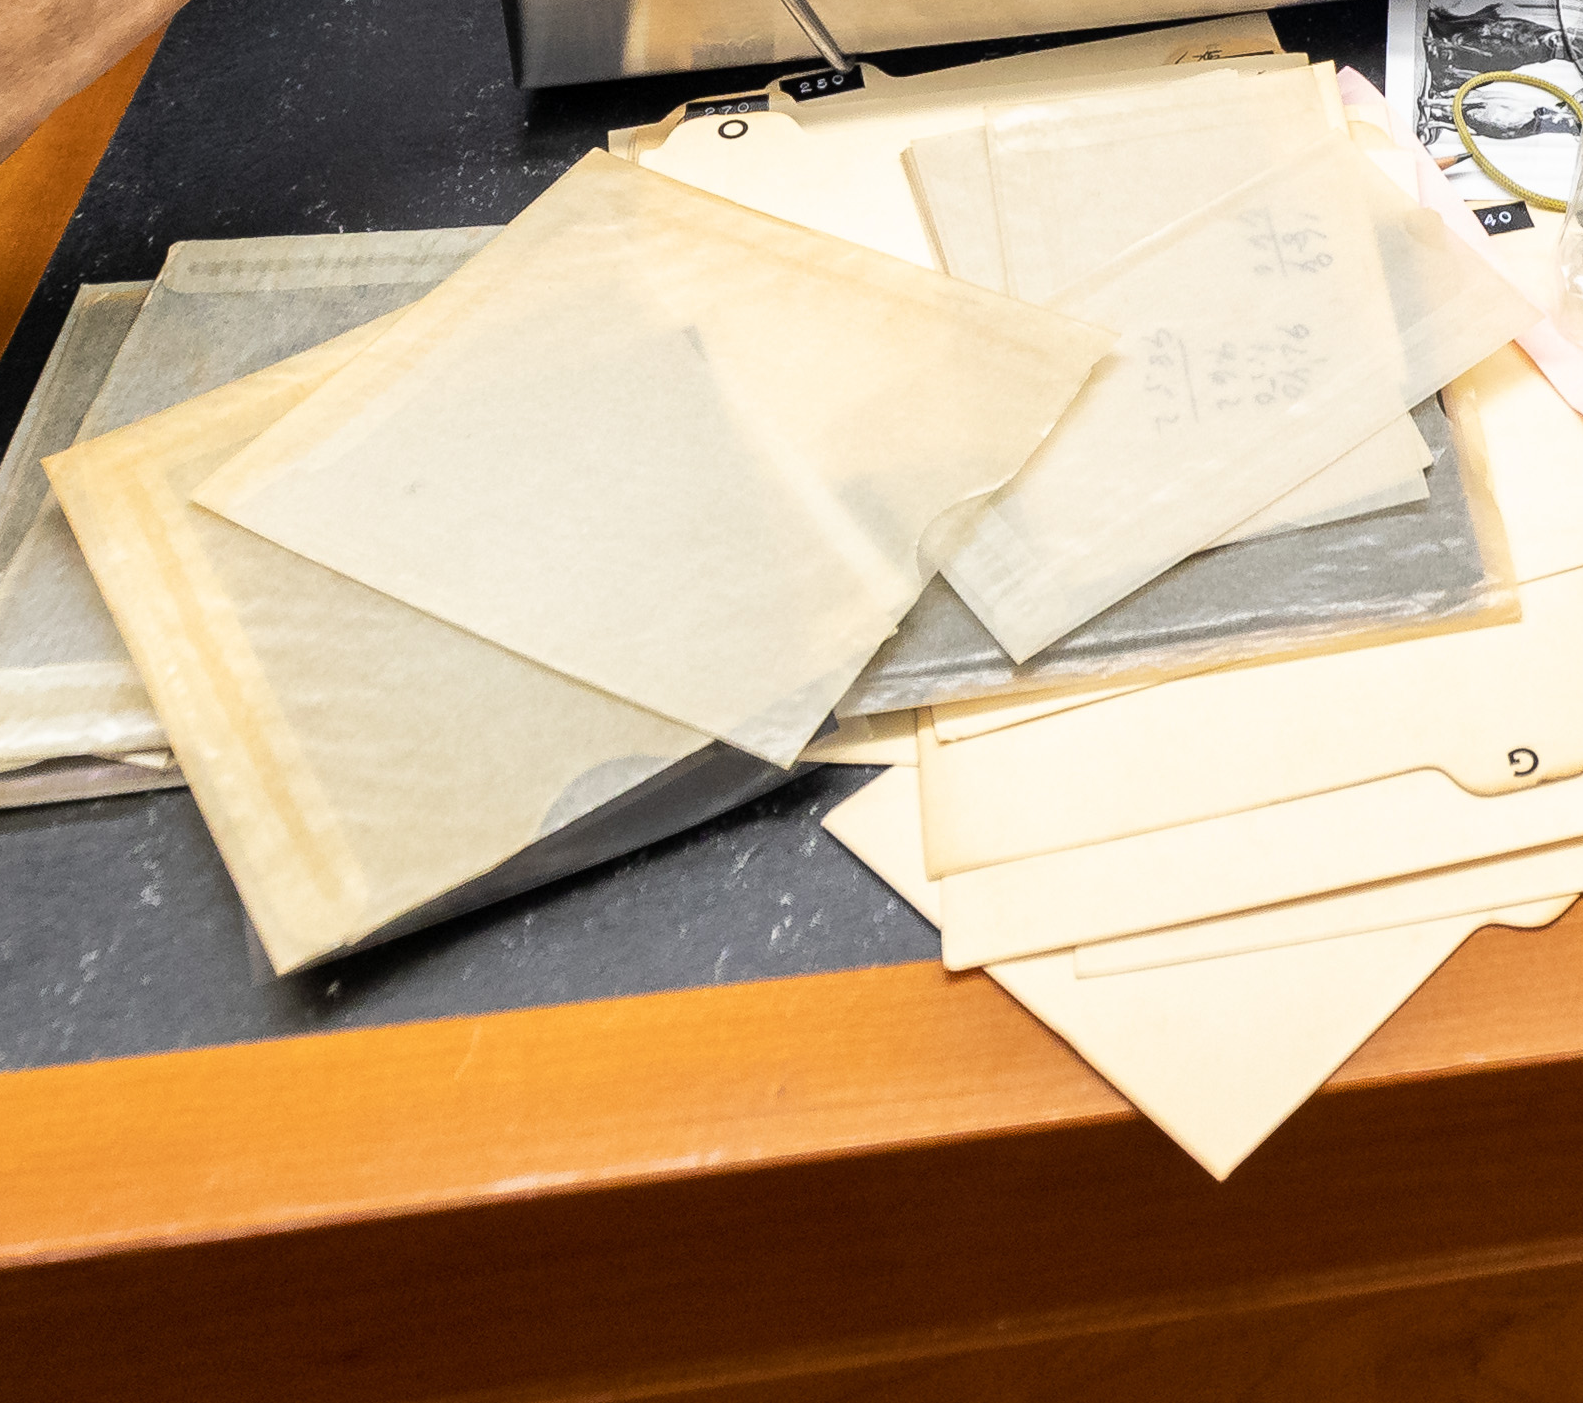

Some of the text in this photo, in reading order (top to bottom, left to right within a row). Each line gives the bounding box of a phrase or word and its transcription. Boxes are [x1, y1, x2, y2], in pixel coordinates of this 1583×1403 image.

[718, 119, 749, 140] O
[1483, 210, 1512, 227] 40
[1507, 747, 1539, 777] G
